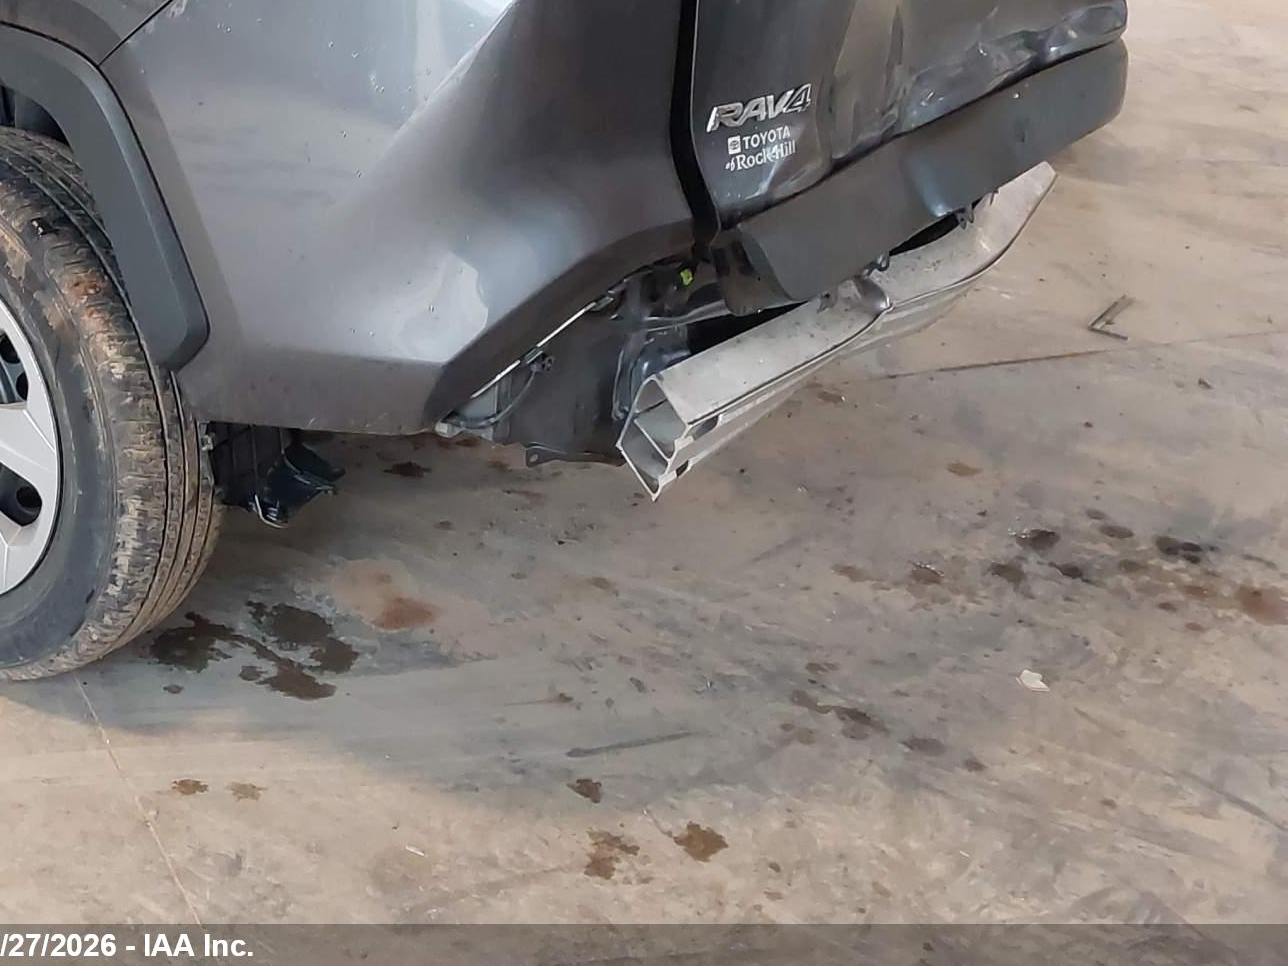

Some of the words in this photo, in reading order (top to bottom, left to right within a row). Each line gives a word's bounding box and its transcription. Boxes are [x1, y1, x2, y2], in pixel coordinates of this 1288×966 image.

[706, 82, 812, 134] RAV4
[742, 125, 791, 150] TOYOTA
[735, 146, 774, 171] Rock
